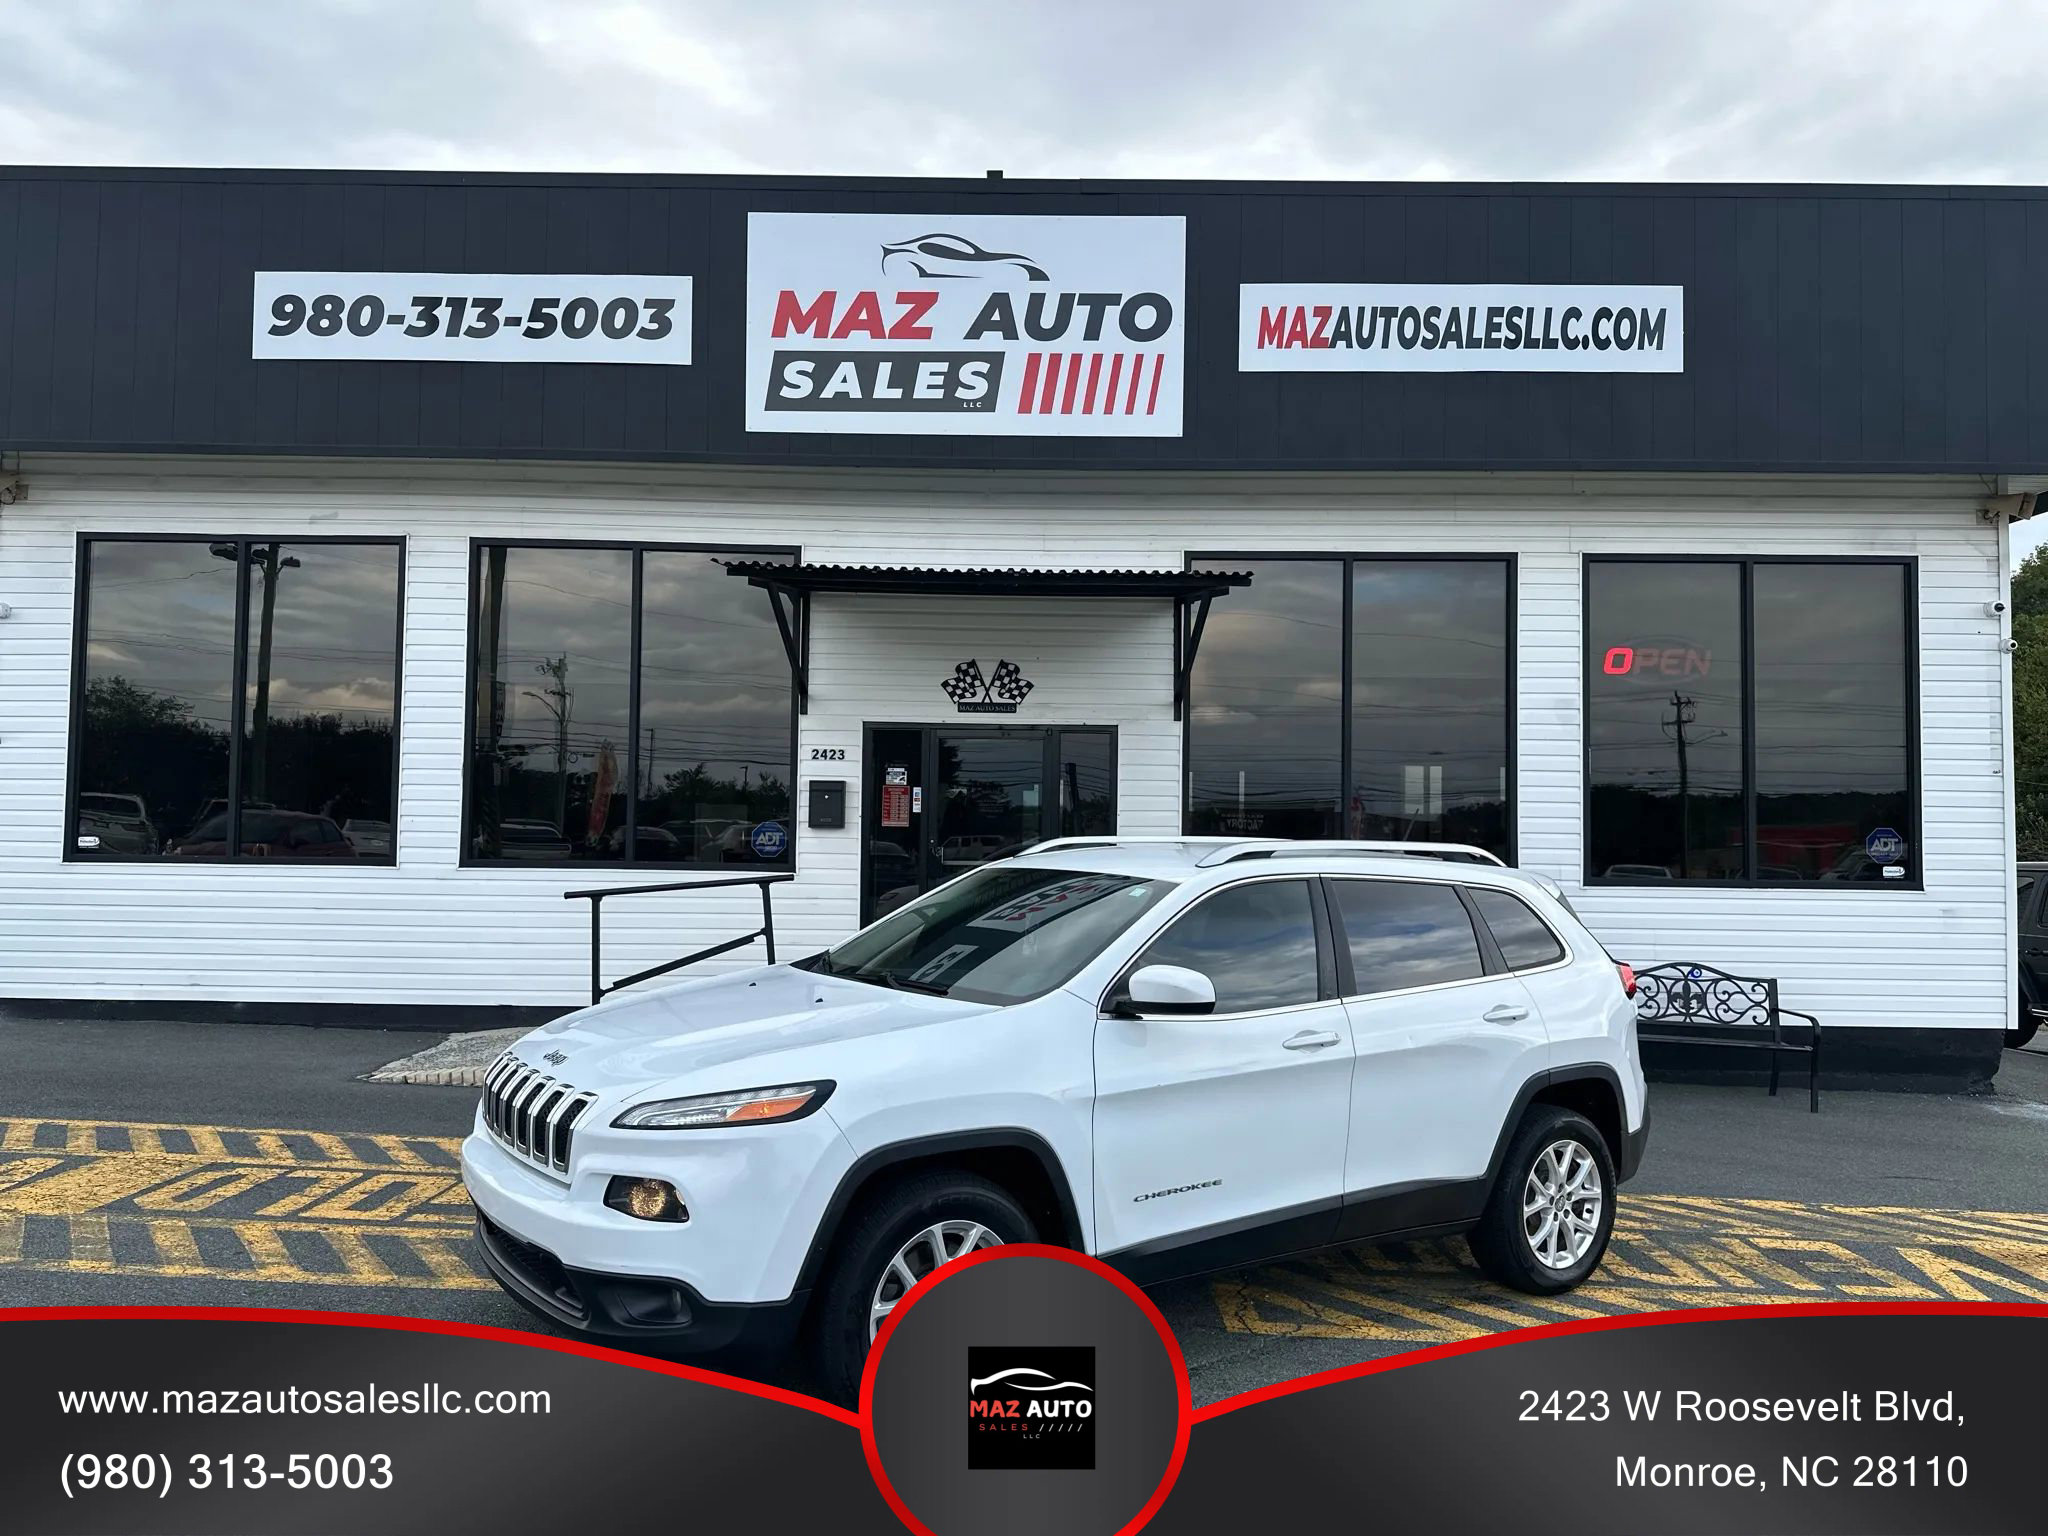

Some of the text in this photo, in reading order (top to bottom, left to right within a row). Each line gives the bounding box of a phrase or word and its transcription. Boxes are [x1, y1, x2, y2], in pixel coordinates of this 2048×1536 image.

[267, 293, 676, 341] 980-313-5003
[770, 290, 1174, 343] MAZ AUTO
[1257, 305, 1667, 352] MAZAUTOSALESLLC.COM
[778, 360, 991, 400] SALES
[1603, 647, 1713, 676] OPEN
[975, 704, 995, 712] AUTO
[995, 704, 1016, 713] SALES
[811, 748, 845, 761] 2423
[755, 832, 783, 846] ADT
[1871, 837, 1899, 852] ADT
[543, 1048, 569, 1067] Jeep
[1133, 1179, 1223, 1203] CHEROKEE
